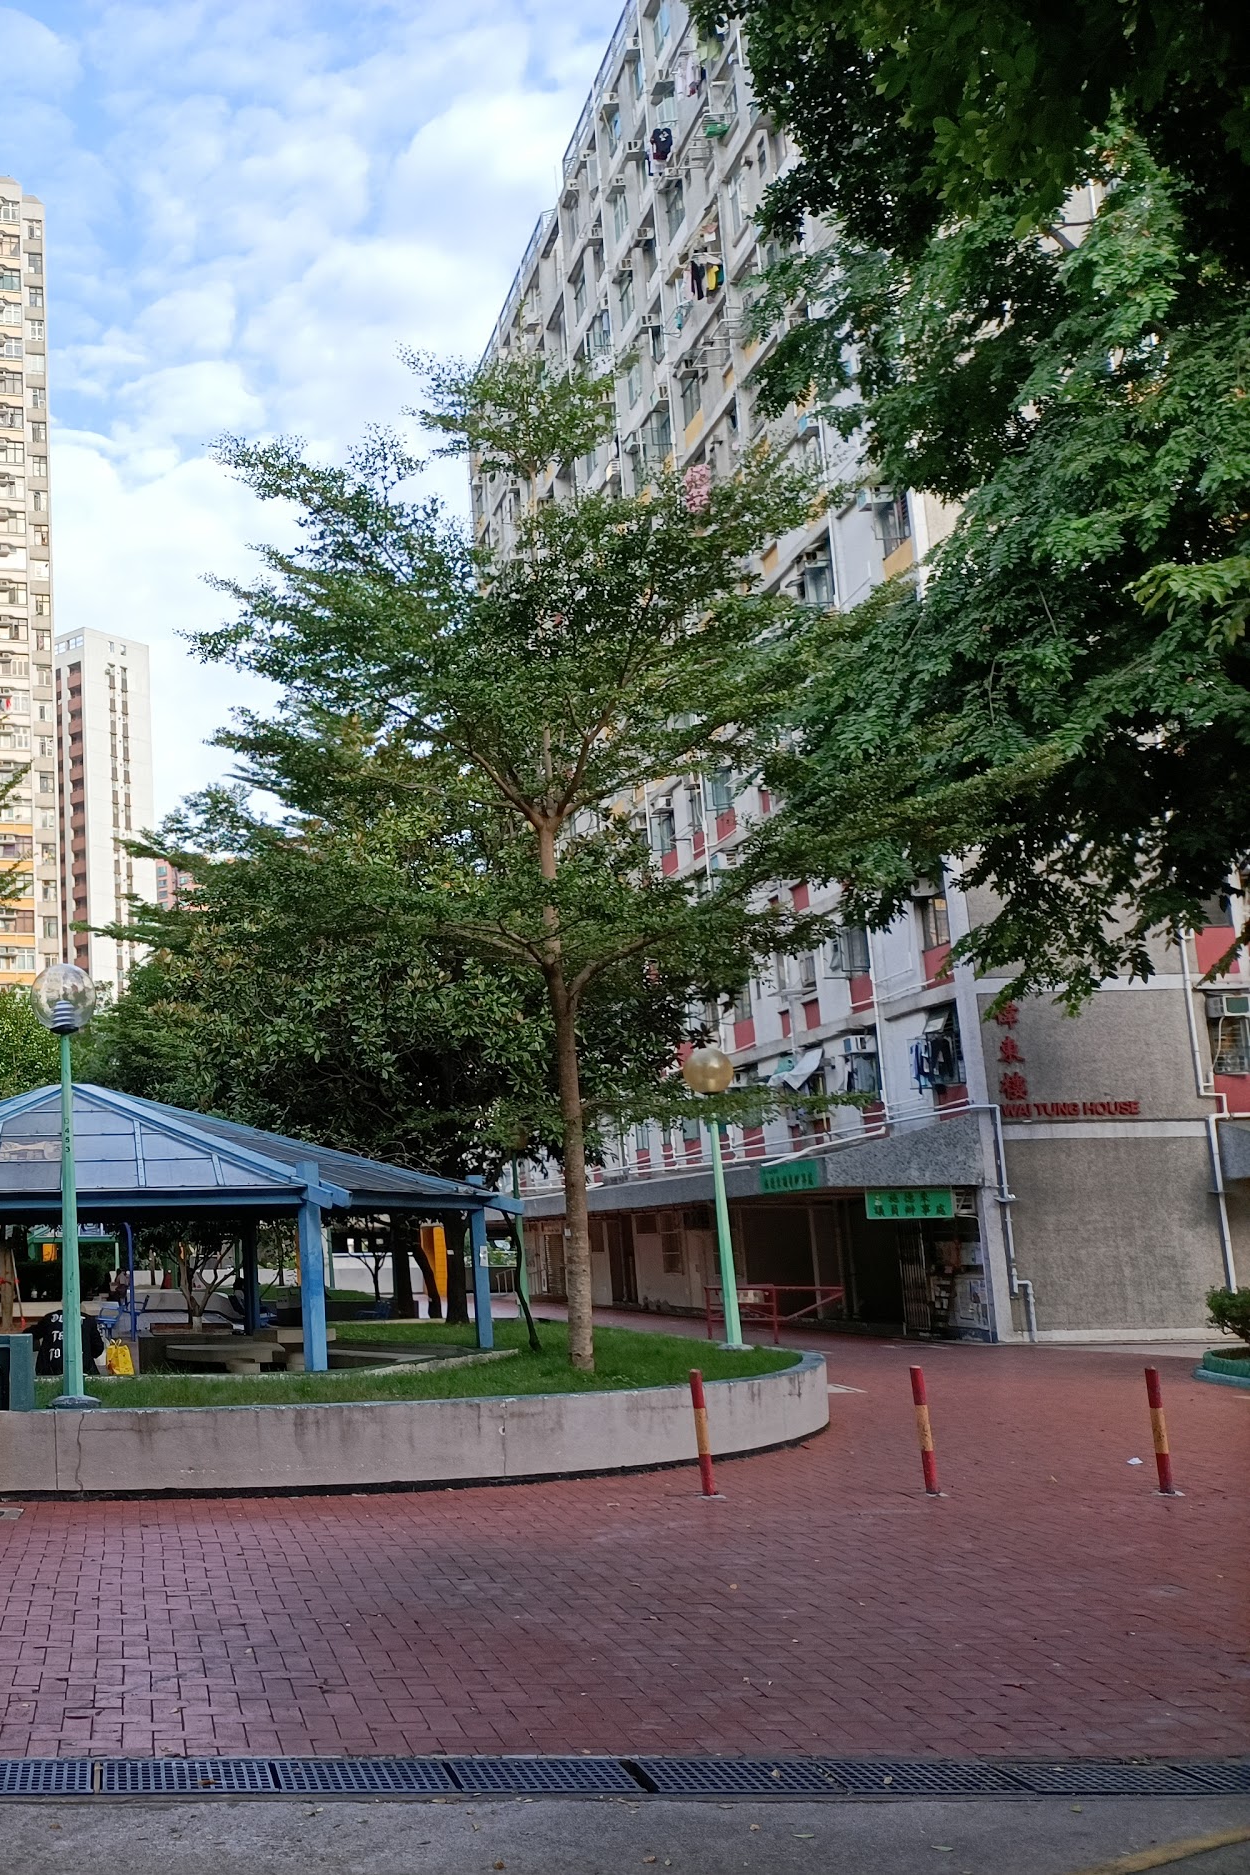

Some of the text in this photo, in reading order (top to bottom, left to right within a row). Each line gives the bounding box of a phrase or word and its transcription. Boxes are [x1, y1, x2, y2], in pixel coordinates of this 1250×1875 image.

[1001, 1101, 1140, 1118] WAI TUNG HOUSE
